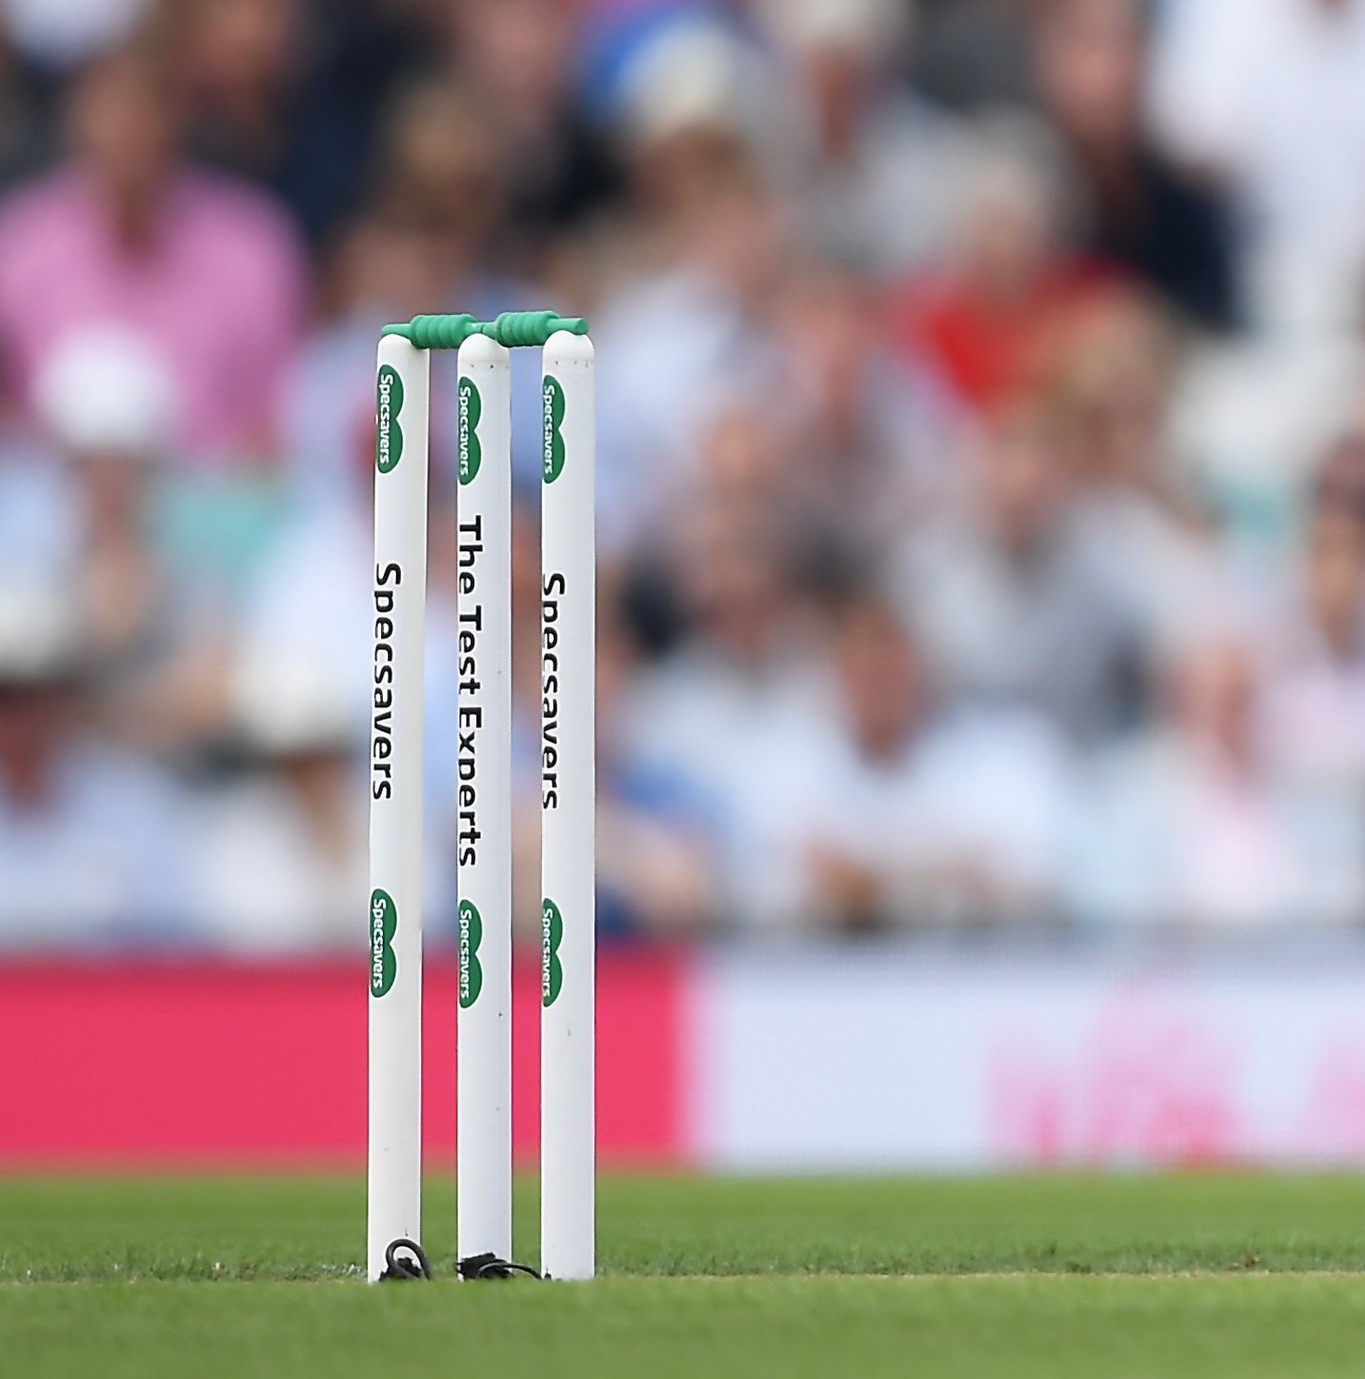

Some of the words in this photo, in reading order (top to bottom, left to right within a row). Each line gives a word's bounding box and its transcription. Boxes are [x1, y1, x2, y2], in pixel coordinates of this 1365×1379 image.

[377, 374, 394, 464] Specsavers
[458, 386, 471, 476] Specsavers
[542, 385, 555, 474] Specsavers
[459, 515, 483, 594] The
[373, 563, 402, 800] Specsavers
[459, 605, 482, 696] Test
[542, 572, 566, 810] Specsavers
[458, 707, 482, 867] Experts
[372, 898, 386, 988] Specsavers
[458, 910, 472, 999] Specsavers
[541, 909, 553, 997] Specsavers
